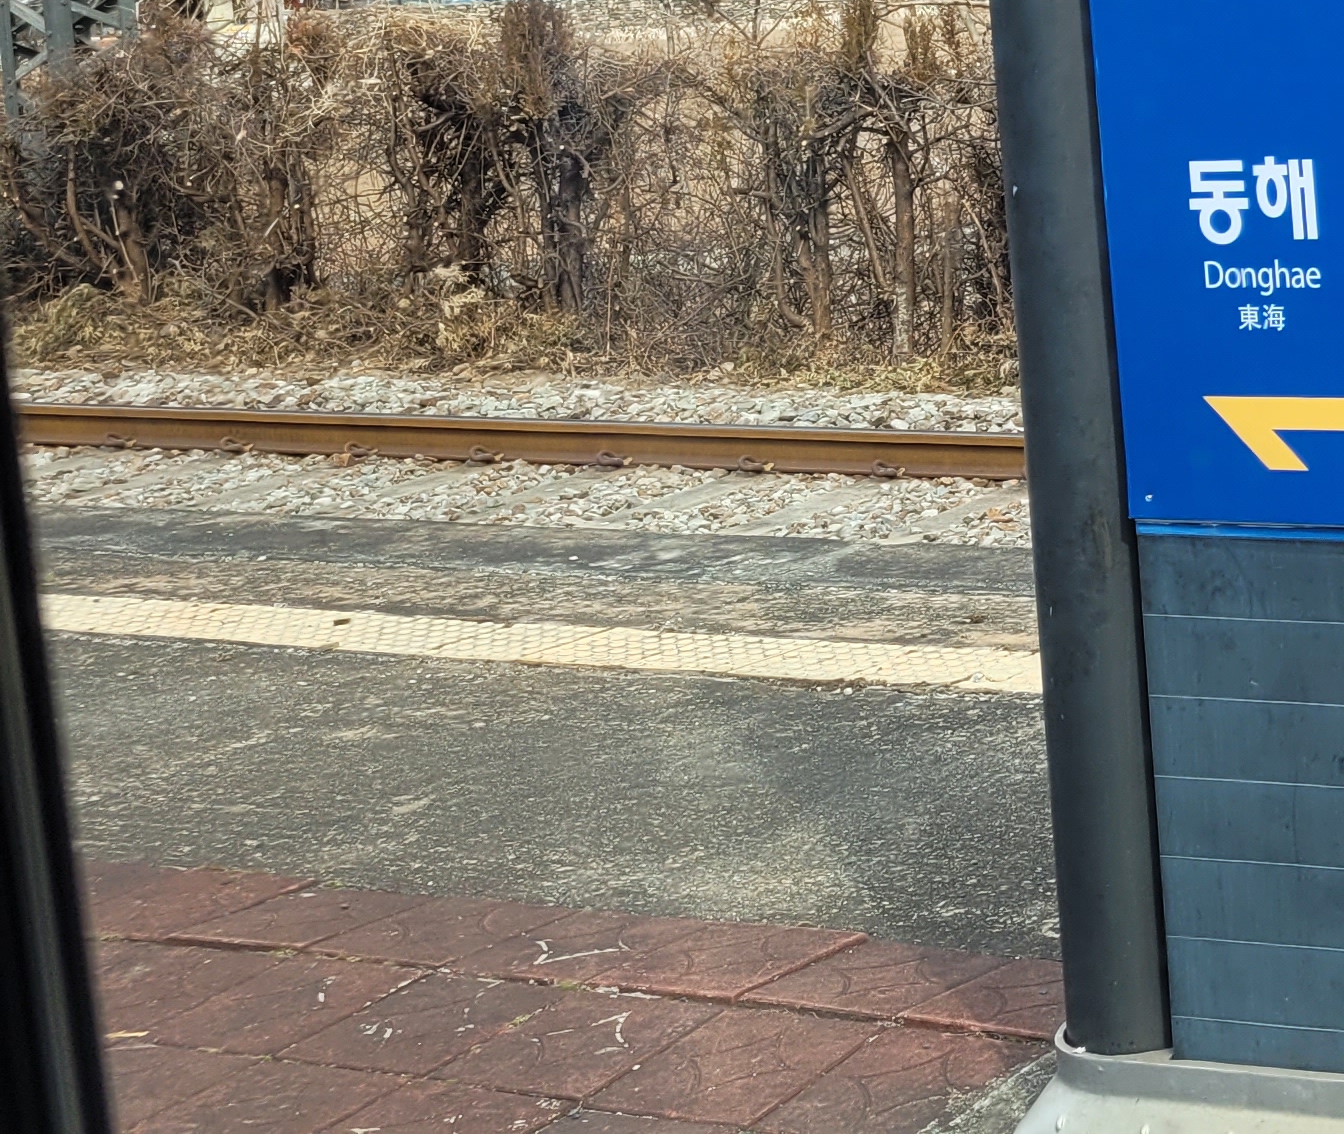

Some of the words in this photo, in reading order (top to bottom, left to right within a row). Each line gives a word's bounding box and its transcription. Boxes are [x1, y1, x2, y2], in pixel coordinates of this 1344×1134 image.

[1188, 155, 1319, 245] 동해
[1203, 259, 1321, 297] Donghae
[1237, 303, 1286, 332] 東海
